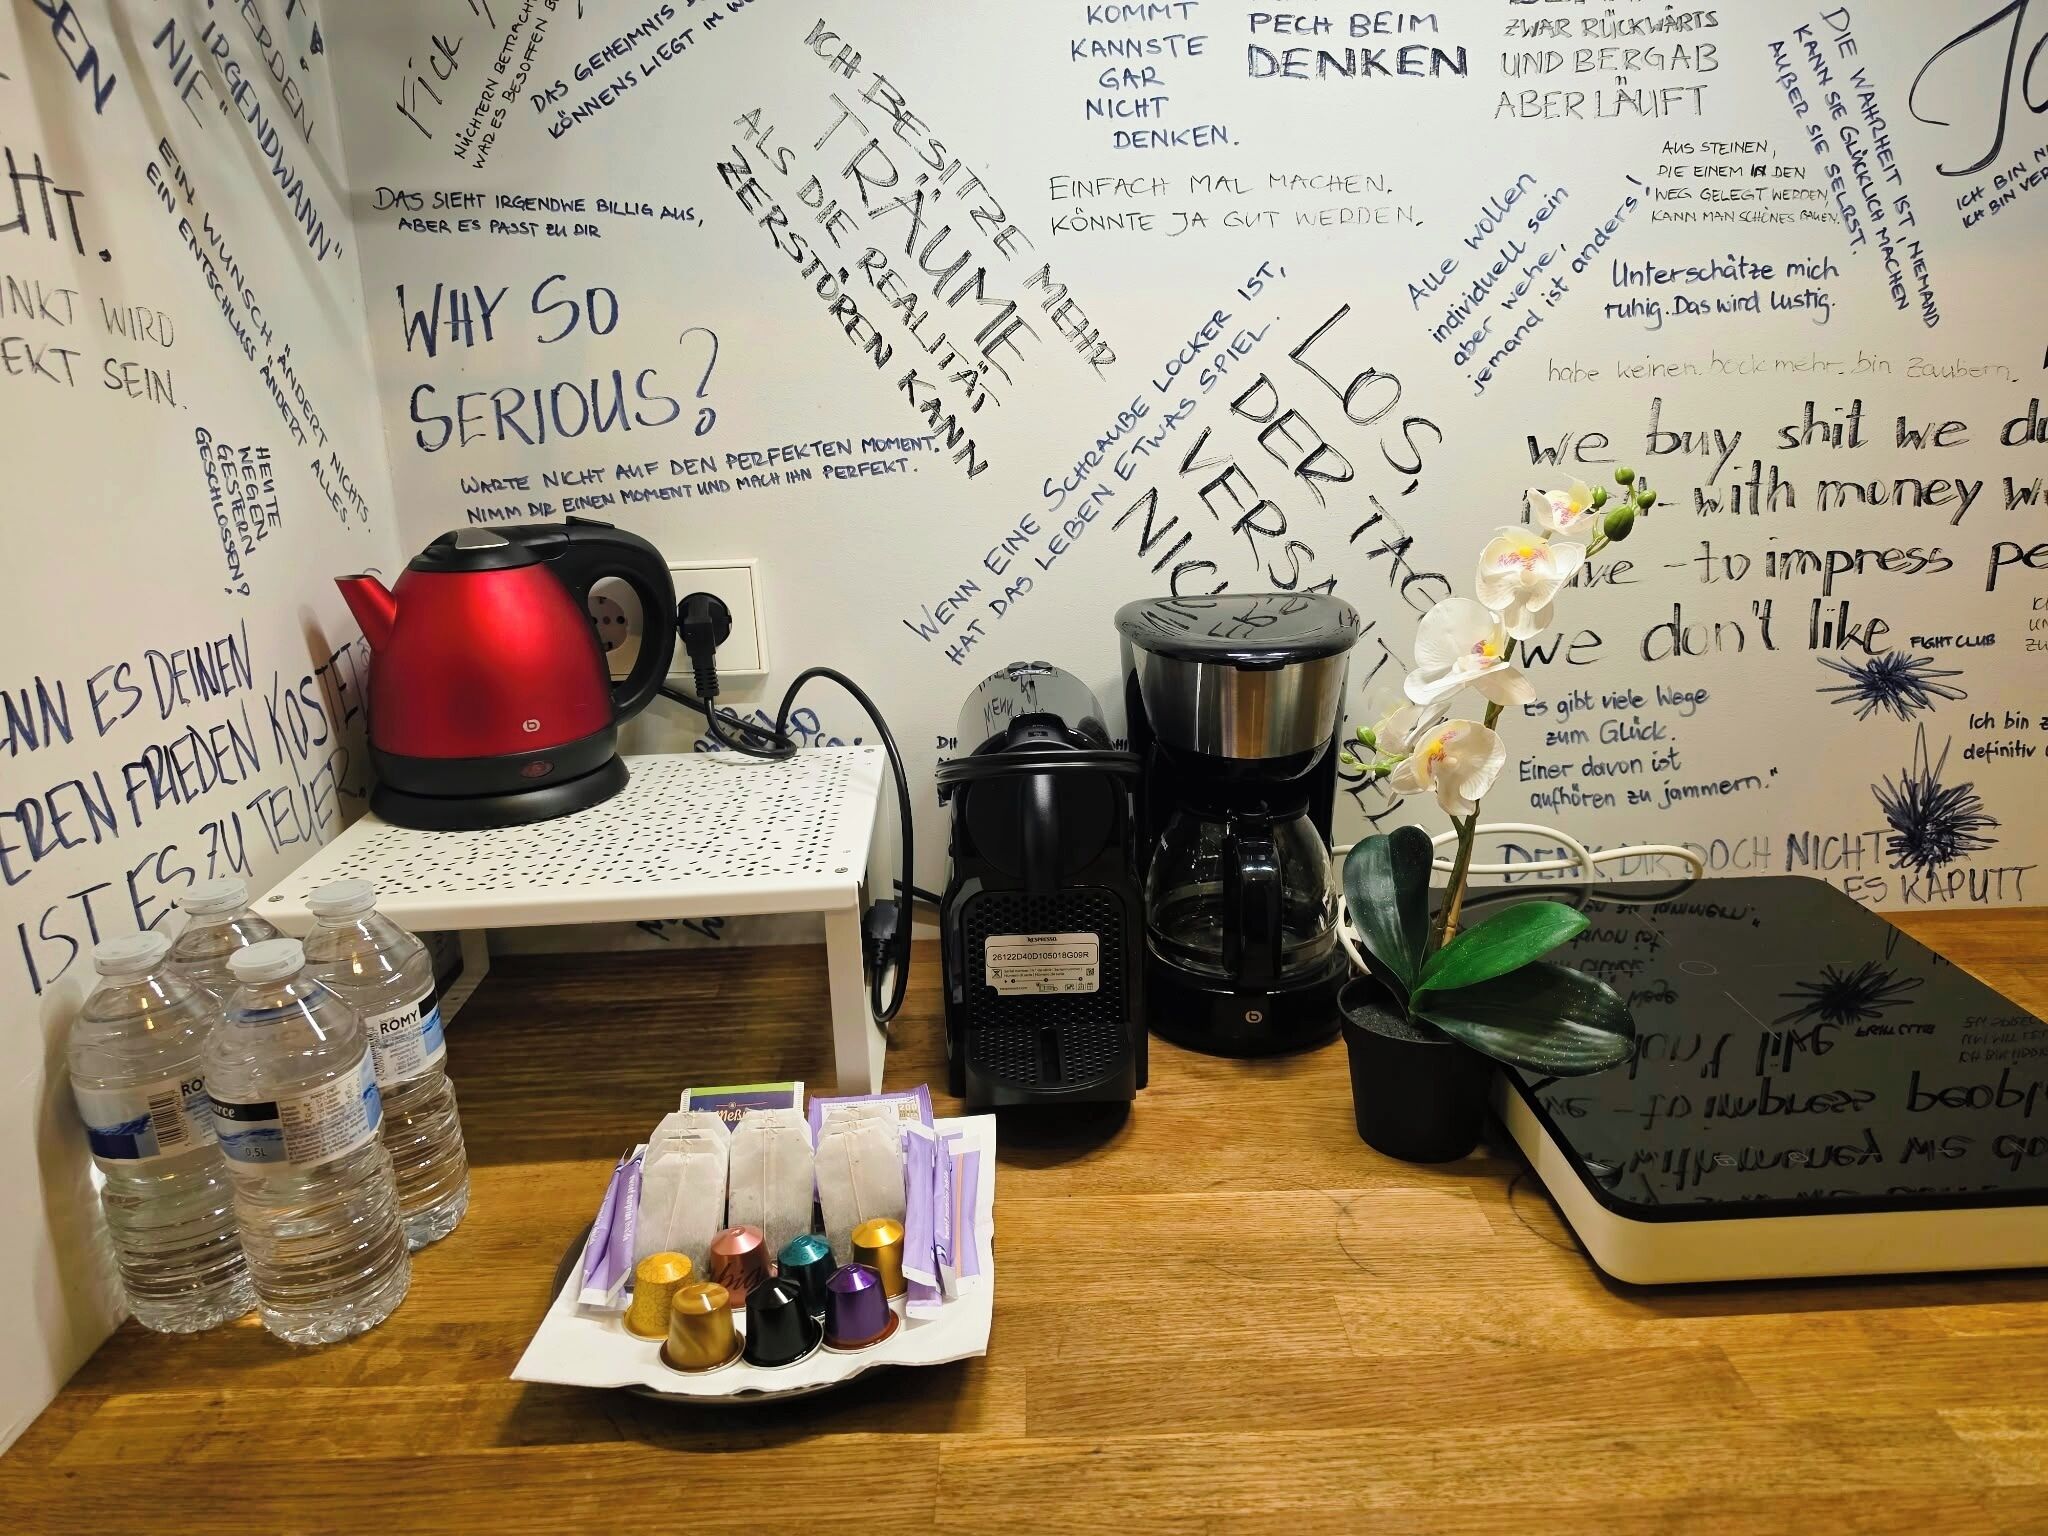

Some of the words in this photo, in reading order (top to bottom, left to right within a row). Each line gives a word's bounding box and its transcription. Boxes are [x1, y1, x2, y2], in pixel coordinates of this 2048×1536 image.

[1087, 2, 1200, 25] KOMMT
[1249, 12, 1333, 35] PECH
[1350, 11, 1439, 38] BEIM
[1503, 18, 1574, 39] ZWAR
[1581, 4, 1719, 39] RÜCKWÄRTS
[531, 80, 569, 113] DAS
[575, 4, 675, 82] GEHEIMNIS
[1071, 35, 1208, 60] KANNSTE
[1248, 43, 1468, 80] DENKEN
[1501, 50, 1564, 78] UND
[1575, 43, 1719, 73] BERGAB
[473, 132, 496, 169] WAR
[502, 17, 548, 104] BESOFFEN
[548, 71, 637, 139] KÖNNENS
[640, 28, 694, 77] LIEGT
[1099, 66, 1165, 90] GAR
[1494, 89, 1584, 119] ABER
[1593, 75, 1708, 119] LÄUFT
[1086, 97, 1170, 120] NICHT
[1113, 125, 1240, 150] DENKEN.
[1662, 141, 1694, 155] AUS
[1700, 140, 1776, 158] STEINEN,
[1806, 125, 1829, 155] SIE
[733, 107, 796, 176] ALS
[796, 174, 860, 248] DIE
[1050, 175, 1170, 200] EINFACH
[1190, 175, 1253, 195] MAL
[1268, 172, 1393, 195] MACHEN.
[1656, 165, 1684, 178] DIE
[1693, 165, 1742, 177] EINEM
[1771, 167, 1806, 178] DEN
[1793, 24, 1832, 85] KANN
[1825, 92, 1847, 121] SIE
[1839, 126, 1884, 222] GLÜCKLICH
[1876, 227, 1909, 310] MACHEN
[1820, 7, 1857, 59] DIE
[1850, 68, 1902, 186] WAHRHEIT
[1907, 241, 1940, 328] NIEMAND
[1957, 186, 1984, 210] ICH
[1993, 162, 2026, 190] BIN
[373, 187, 424, 211] DAS
[433, 191, 486, 209] SIEHT
[596, 198, 653, 217] BILLIG
[660, 206, 703, 227] AUS,
[804, 17, 862, 79] ICH
[858, 72, 1034, 262] BESITZE
[1022, 262, 1117, 382] MEHR
[1464, 174, 1537, 250] wollen
[1651, 210, 1697, 223] KANN
[1703, 212, 1735, 222] MAN
[1655, 188, 1691, 201] WEG
[1700, 187, 1769, 202] GELEGT
[1962, 209, 1985, 228] ICH
[1988, 189, 2016, 215] BIN
[159, 137, 195, 205] EIN
[203, 212, 272, 346] WUNSCH
[398, 218, 451, 235] ABER
[458, 219, 481, 233] ES
[490, 219, 539, 237] PASST
[546, 220, 567, 237] ZU
[573, 222, 601, 239] DIR
[814, 92, 1043, 385] TRÄUME
[1051, 207, 1156, 235] KÖNNTE
[1167, 212, 1209, 237] JA
[1223, 210, 1280, 229] GUT
[147, 161, 176, 213] EIN
[179, 217, 257, 361] ENTSCHLUSS
[1428, 241, 1526, 343] individuell
[1527, 186, 1569, 234] sein
[1611, 254, 1775, 288] Unterschätze
[1786, 256, 1840, 281] mich
[101, 297, 174, 347] WIRD
[396, 282, 509, 358] WHY
[532, 274, 619, 344] SO
[717, 144, 893, 370] ZERSTÖREN
[898, 368, 990, 480] KANN
[1717, 291, 1761, 315] wird
[1771, 288, 1836, 326] lustig.
[1453, 315, 1492, 366] aber
[1466, 309, 1544, 397] jemand
[1541, 276, 1569, 307] ist
[104, 358, 187, 410] SEIN.
[410, 327, 719, 453] SERIOUS?
[1548, 359, 1600, 383] habe
[1287, 302, 1444, 498] LOS,
[461, 475, 530, 494] WARTE
[542, 469, 605, 487] NICHT
[616, 462, 659, 479] AUF
[670, 457, 717, 476] DEN
[726, 439, 852, 470] PERFEKTEN
[862, 434, 940, 454] MOMENT.
[902, 578, 982, 642] WENN
[983, 513, 1042, 576] EINE
[1043, 395, 1151, 512] SCHRAUBE
[1152, 308, 1233, 393] LOCKER
[1237, 260, 1288, 301] IST,
[1229, 371, 1356, 510] DER
[1527, 434, 1617, 466] we
[1646, 397, 1742, 486] buy
[1777, 398, 1868, 450] shit
[1896, 415, 1968, 450] we
[195, 426, 250, 595] GESCHLOSSEN?
[217, 444, 256, 555] GESTERN
[238, 446, 268, 541] WEGEN
[256, 446, 281, 527] HEUTE
[467, 506, 523, 524] NIMM
[528, 504, 557, 517] DIR
[563, 493, 616, 514] EINEN
[621, 485, 693, 505] MOMENT
[697, 481, 731, 498] UND
[736, 473, 781, 490] MACH
[786, 467, 812, 482] IHN
[823, 457, 918, 479] PERFEKT.
[1693, 460, 1796, 517] with
[1818, 478, 1983, 526] money
[944, 618, 988, 666] HAT
[988, 575, 1035, 620] DAS
[1035, 483, 1116, 572] LEBEN
[1113, 397, 1198, 482] ETWAS
[1766, 538, 1953, 596] impress
[1520, 628, 1603, 668] we
[1641, 598, 1779, 661] don't
[1808, 597, 1892, 655] like
[1910, 635, 1952, 648] FIGHT
[1956, 634, 1995, 648] CLUB
[87, 662, 142, 737] ES
[144, 618, 252, 720] DEINEN
[1557, 690, 1594, 723] gibt
[1602, 688, 1648, 710] viele
[1656, 685, 1709, 717] Wege
[1969, 713, 1995, 729] Ich
[2004, 711, 2029, 729] bin
[122, 699, 260, 827] FRIEDEN
[1545, 731, 1589, 746] zum
[1963, 739, 2036, 763] definitiv
[1519, 756, 1573, 782] Einer
[1582, 755, 1642, 776] davon
[1652, 747, 1681, 772] ist
[1530, 783, 1616, 814] aufhören
[1627, 789, 1651, 804] zu
[1683, 833, 1771, 875] DOCH
[1785, 831, 1895, 872] NICHT
[1900, 864, 2037, 903] KAPUTT
[17, 883, 112, 996] IST
[127, 845, 195, 931] ES
[380, 1009, 418, 1034] ROMY
